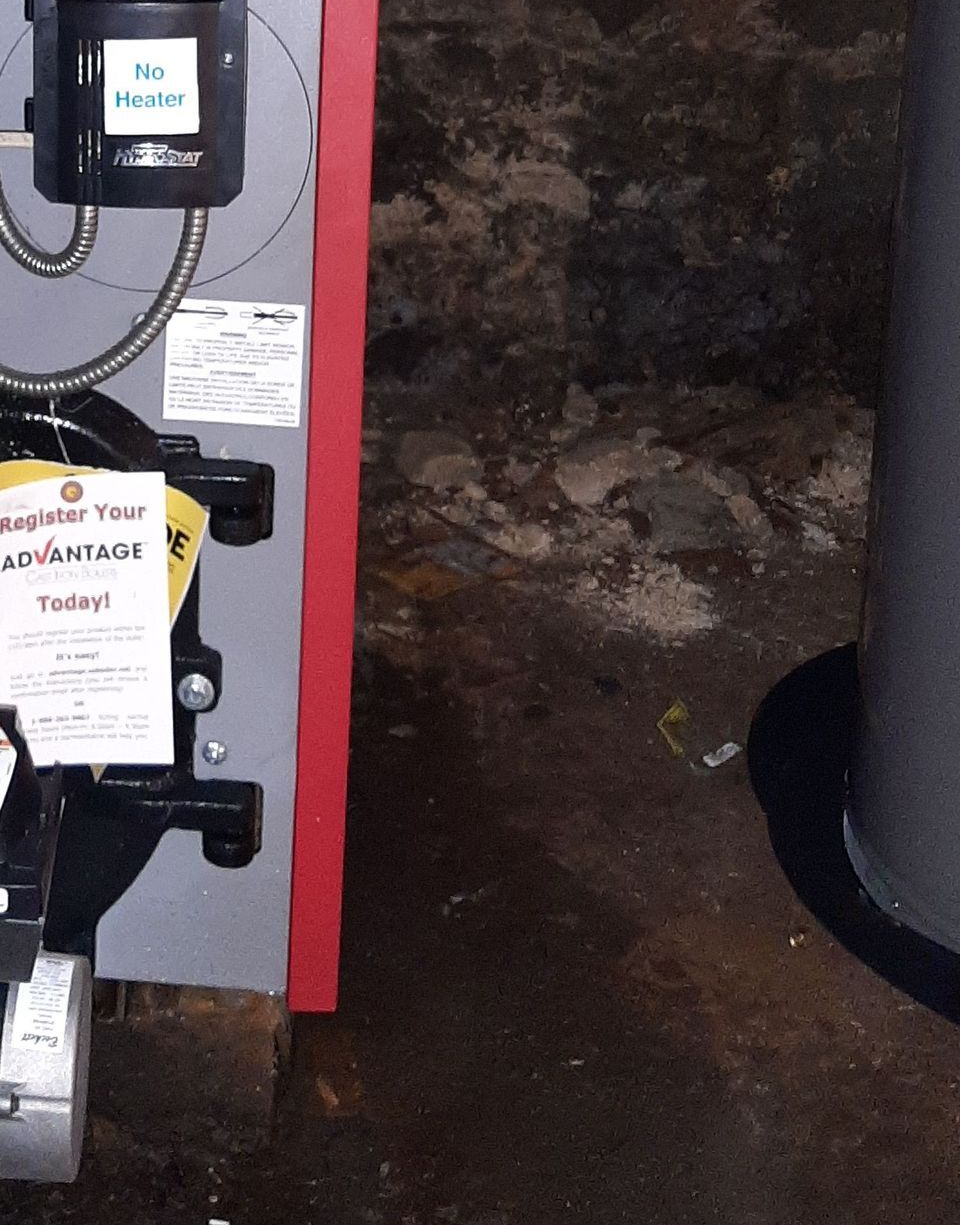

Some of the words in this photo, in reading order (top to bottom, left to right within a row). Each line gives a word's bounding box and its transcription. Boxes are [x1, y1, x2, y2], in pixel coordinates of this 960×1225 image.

[135, 63, 165, 81] No
[115, 91, 186, 108] Heater
[0, 508, 87, 535] Register
[94, 503, 146, 521] Your
[1, 537, 143, 572] ADVANTAGE
[37, 592, 111, 614] Today!
